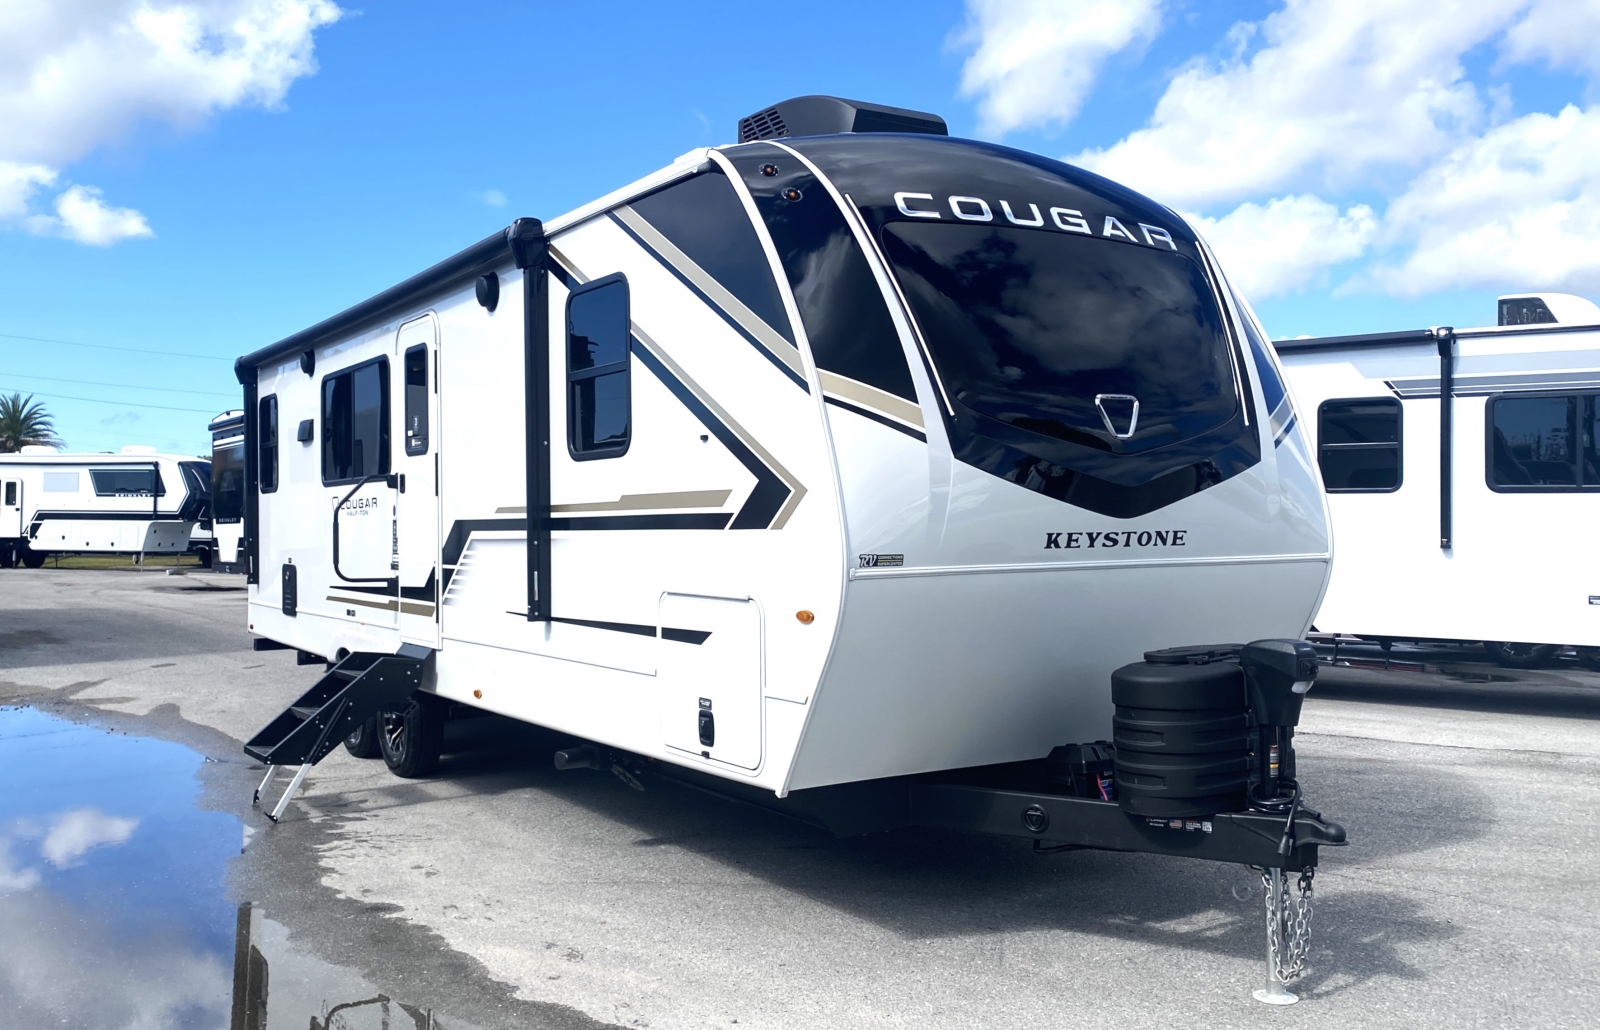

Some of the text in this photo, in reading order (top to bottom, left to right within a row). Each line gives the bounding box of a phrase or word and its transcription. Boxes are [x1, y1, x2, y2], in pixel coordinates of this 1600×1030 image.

[893, 191, 1178, 251] COUGAR
[346, 509, 369, 517] HALF-TON
[1044, 530, 1187, 549] KEYSTONE
[860, 554, 877, 567] RV
